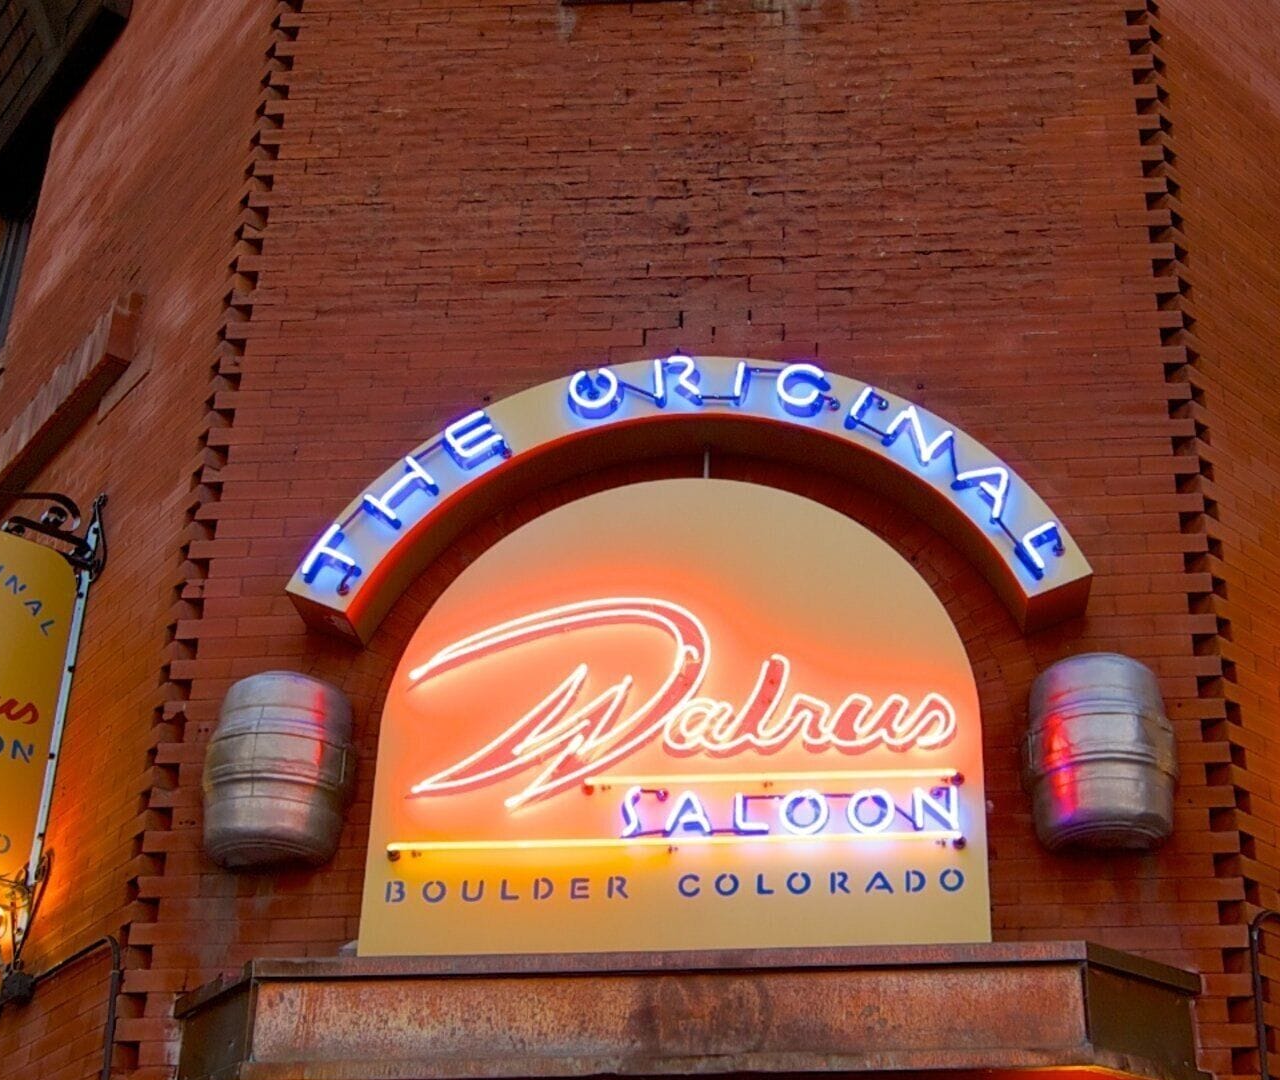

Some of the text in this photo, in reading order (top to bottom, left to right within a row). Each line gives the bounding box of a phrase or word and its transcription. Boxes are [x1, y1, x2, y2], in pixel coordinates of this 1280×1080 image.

[301, 354, 1067, 587] THE ORIGINAL
[409, 597, 958, 809] Walrus
[622, 786, 961, 838] SALOON
[385, 868, 965, 903] BOULDER COLORADO
